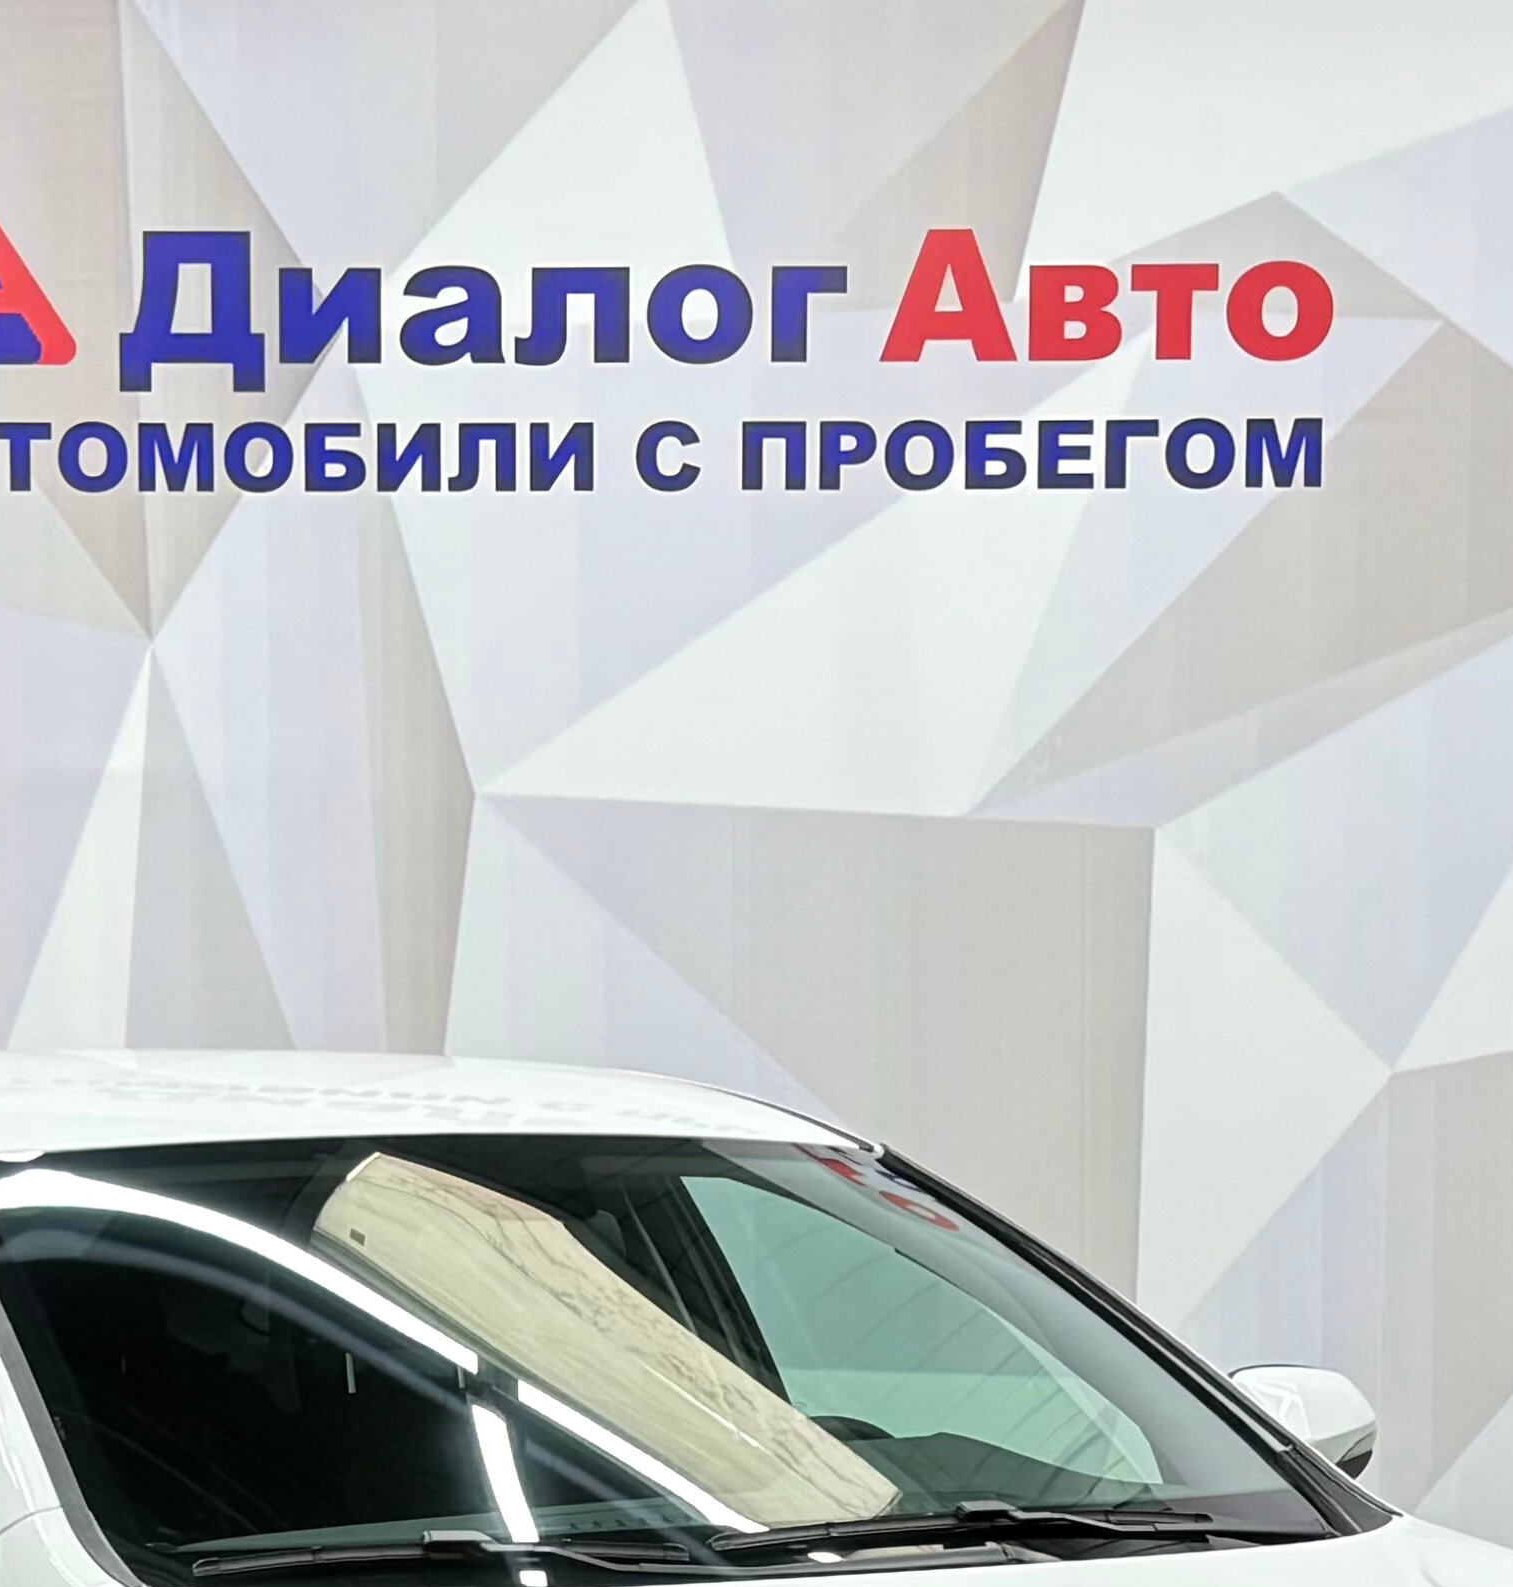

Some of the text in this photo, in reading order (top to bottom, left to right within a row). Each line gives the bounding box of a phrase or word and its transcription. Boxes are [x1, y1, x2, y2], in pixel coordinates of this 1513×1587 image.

[117, 228, 1335, 393] Диалог Авто
[634, 420, 701, 491] С
[741, 417, 1325, 491] ПРОБЕГОМ
